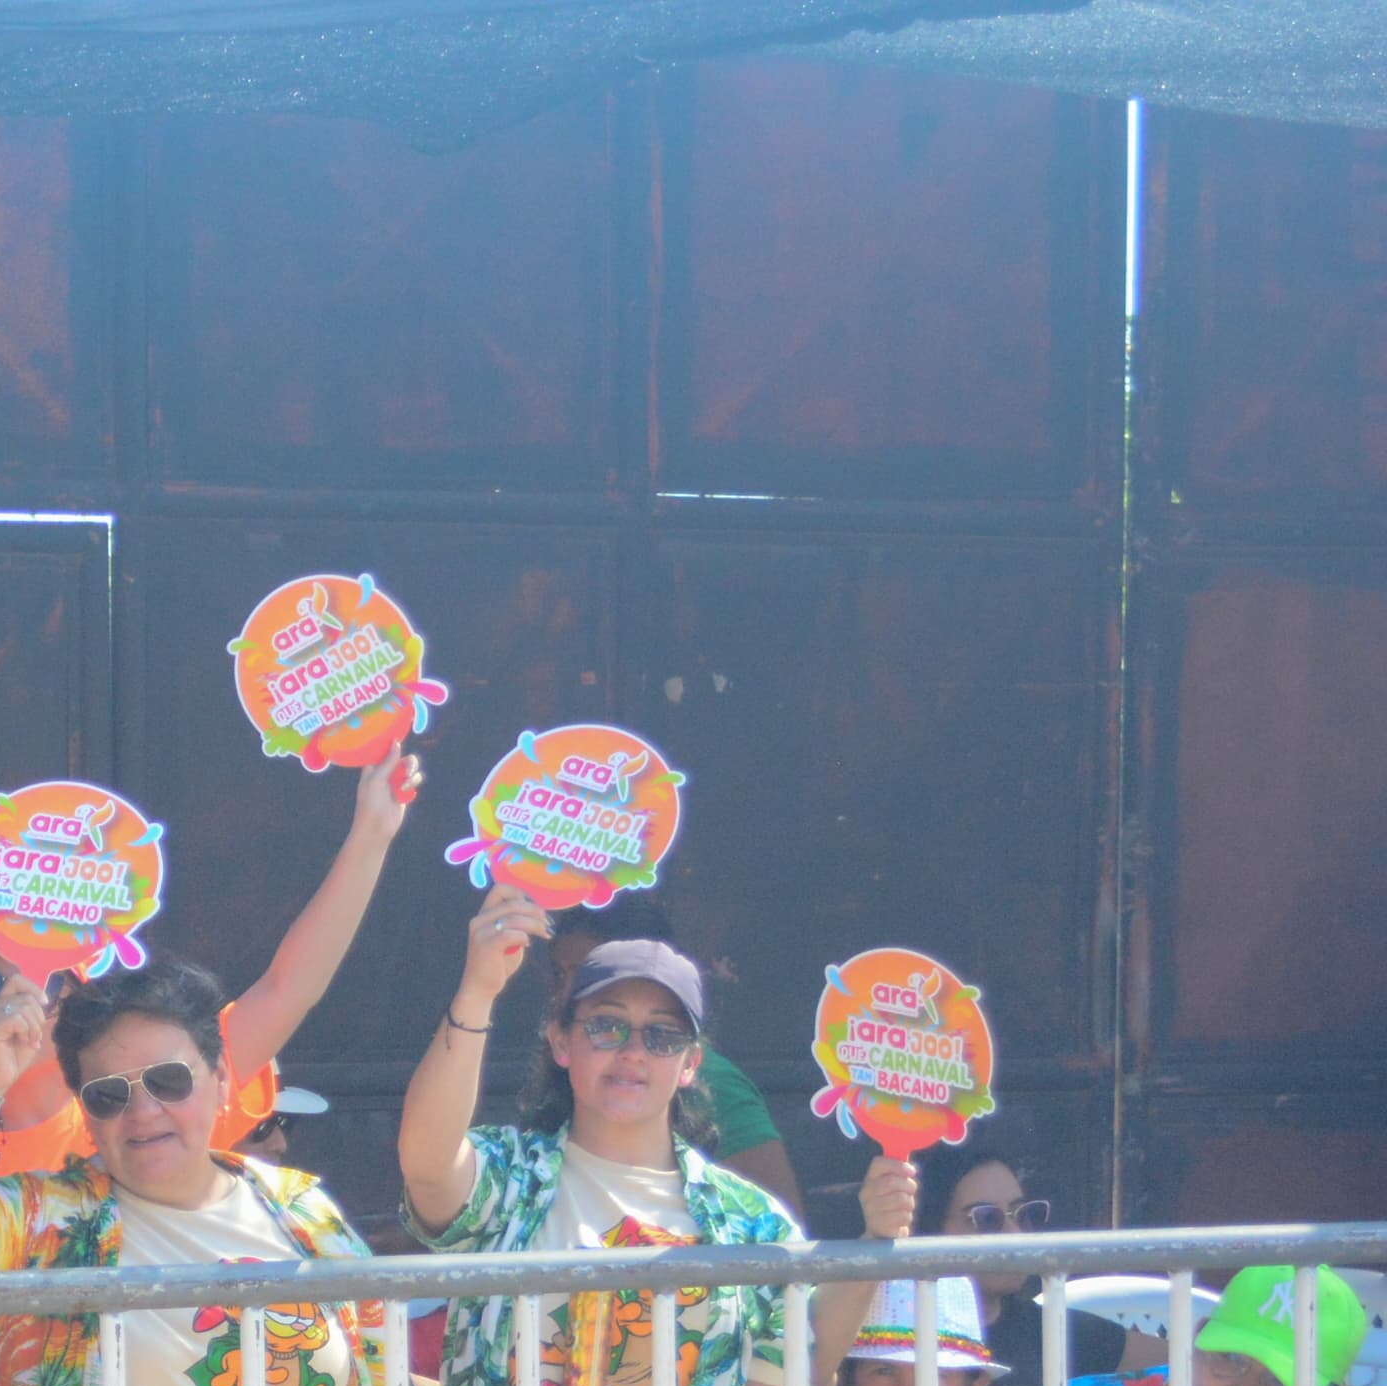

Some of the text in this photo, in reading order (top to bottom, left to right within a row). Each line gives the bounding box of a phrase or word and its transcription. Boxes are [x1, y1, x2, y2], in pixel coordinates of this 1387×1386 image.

[274, 617, 318, 650] ara
[327, 626, 377, 669] JOO!
[302, 645, 402, 708] CARNAVAL
[320, 675, 388, 721] BACANO
[563, 758, 613, 784] ara
[31, 815, 82, 836] ara
[584, 805, 644, 836] JOO!
[531, 812, 639, 862] CARNAVAL
[531, 835, 608, 869] BACANO
[65, 860, 127, 885] JOO!
[13, 873, 129, 908] CARNAVAL
[18, 896, 99, 922] BACANO
[873, 985, 918, 1009] ara
[910, 1031, 962, 1061] JOO!
[868, 1048, 972, 1087] CARNAVAL
[878, 1071, 947, 1101] BACANO
